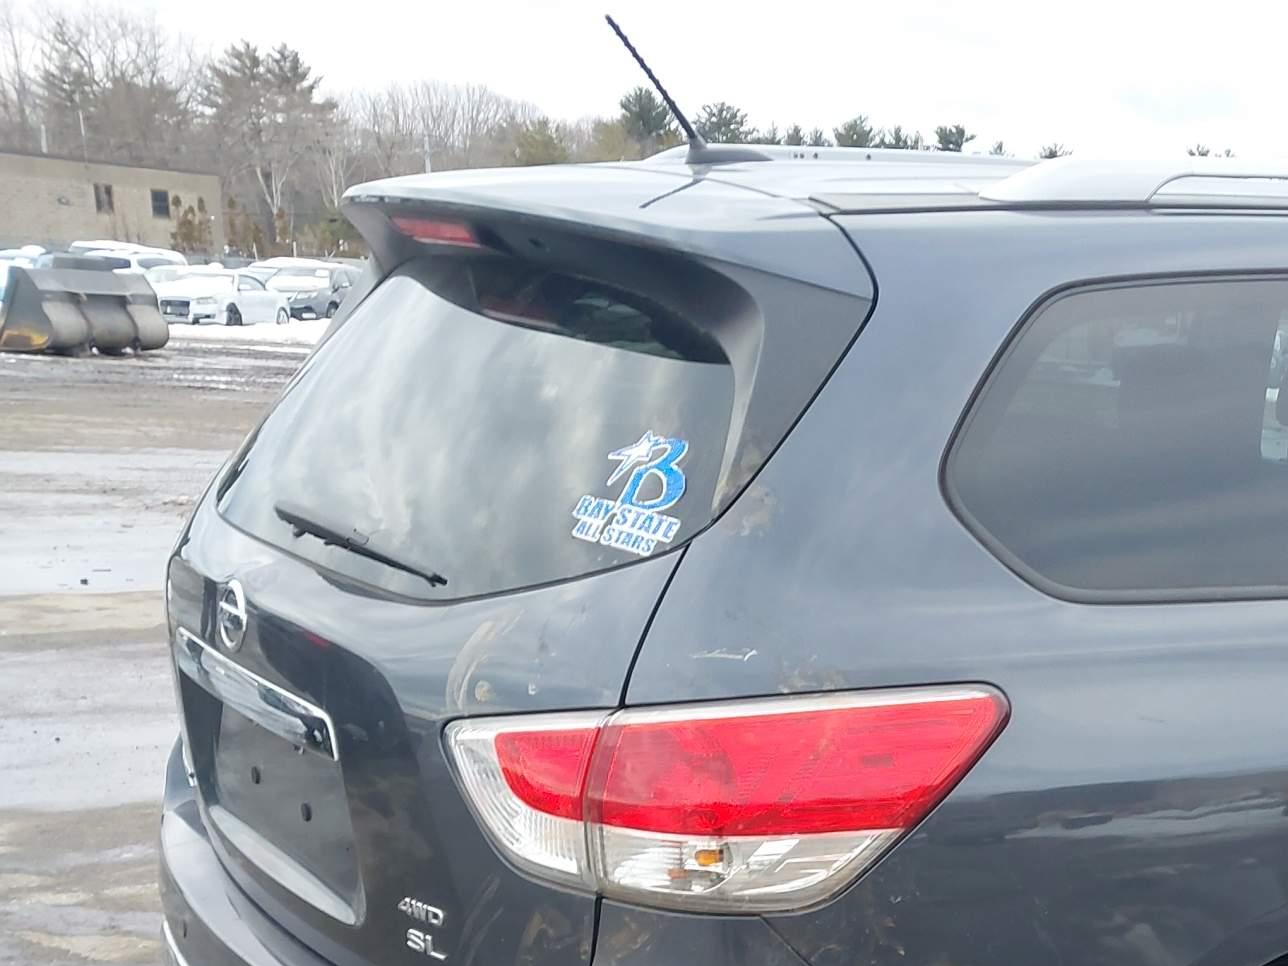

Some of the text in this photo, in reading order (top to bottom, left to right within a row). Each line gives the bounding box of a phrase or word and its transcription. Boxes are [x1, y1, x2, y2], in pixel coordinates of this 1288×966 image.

[575, 496, 678, 539] BAY STATE
[575, 520, 655, 553] ALL STARS
[398, 897, 444, 926] 4WD
[406, 928, 447, 960] SL
